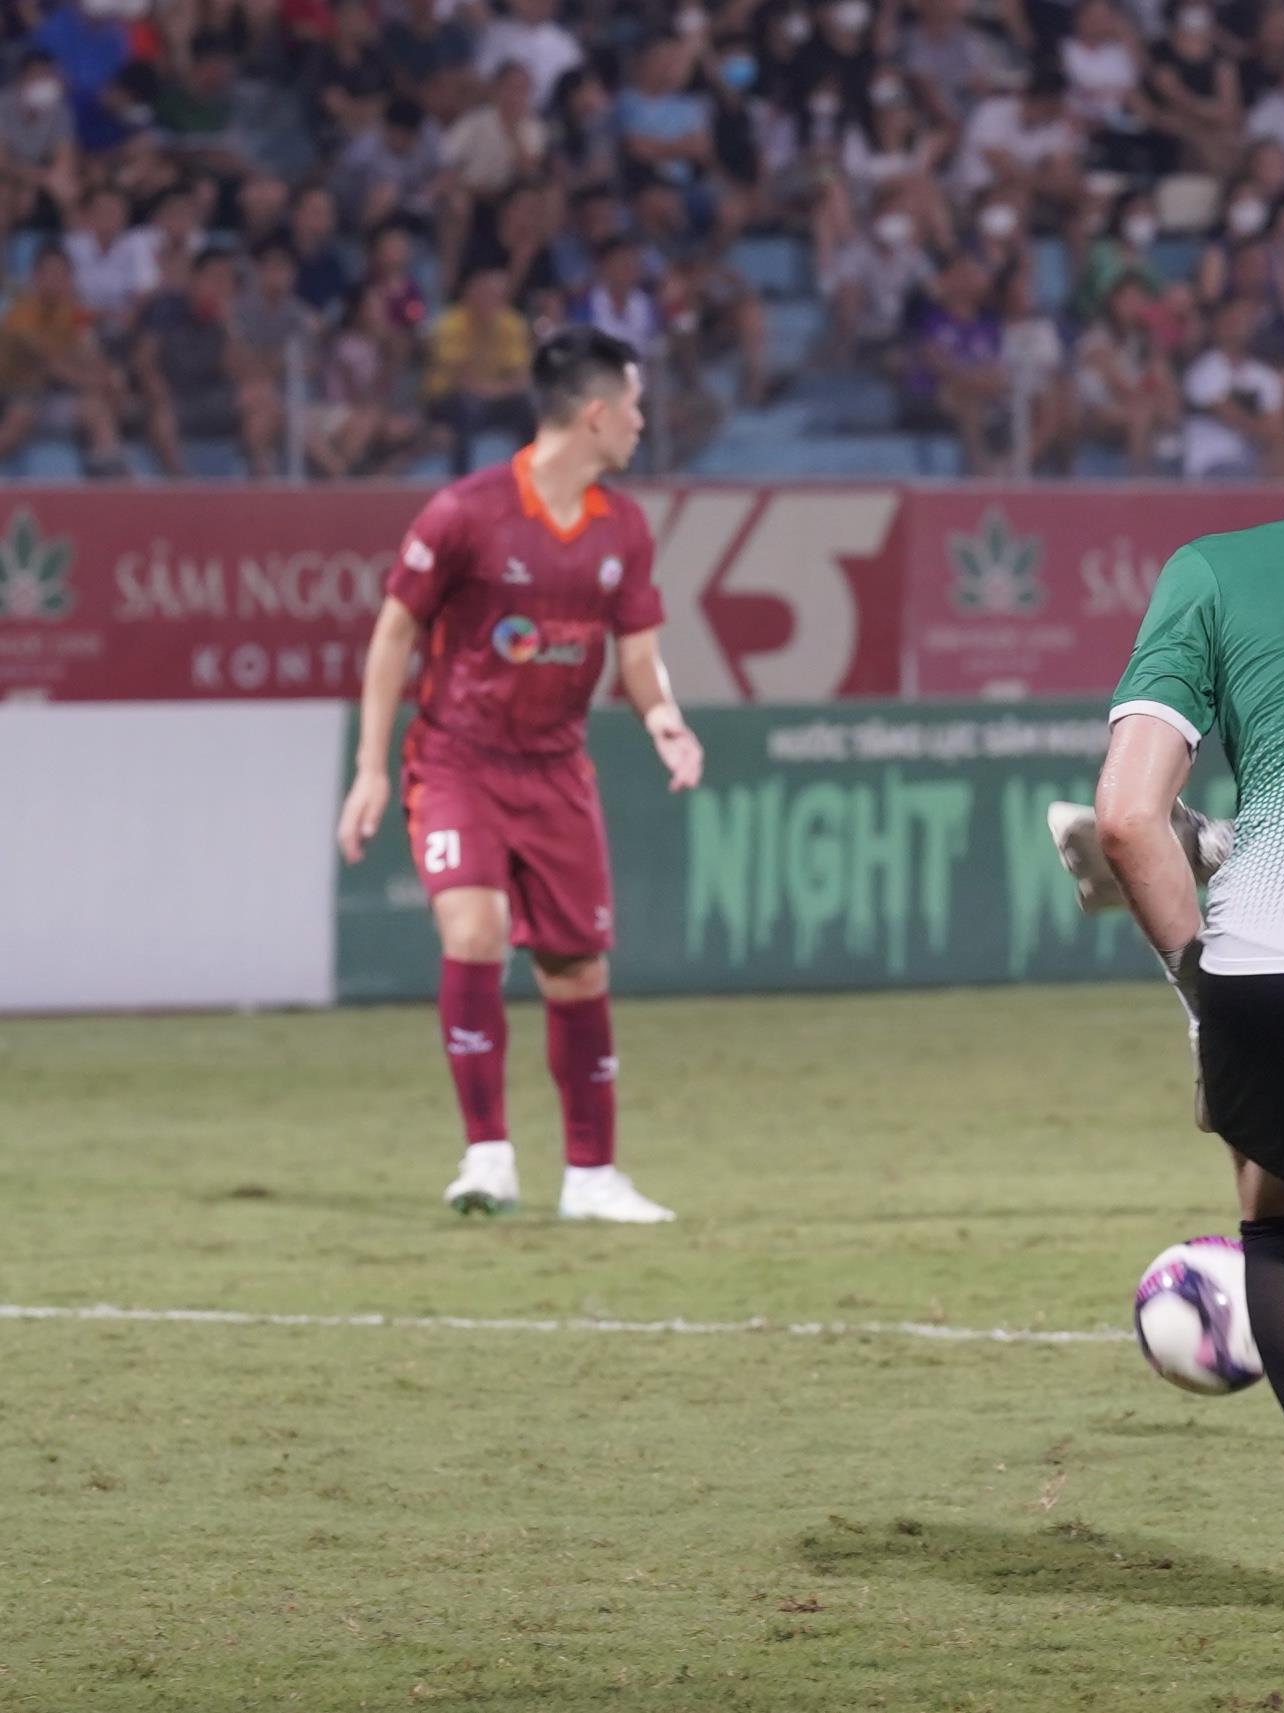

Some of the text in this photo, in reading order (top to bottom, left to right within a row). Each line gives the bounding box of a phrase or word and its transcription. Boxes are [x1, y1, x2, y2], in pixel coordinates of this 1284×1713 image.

[191, 642, 421, 691] KONT
[424, 829, 460, 873] 21
[685, 765, 977, 978] NIGHT
